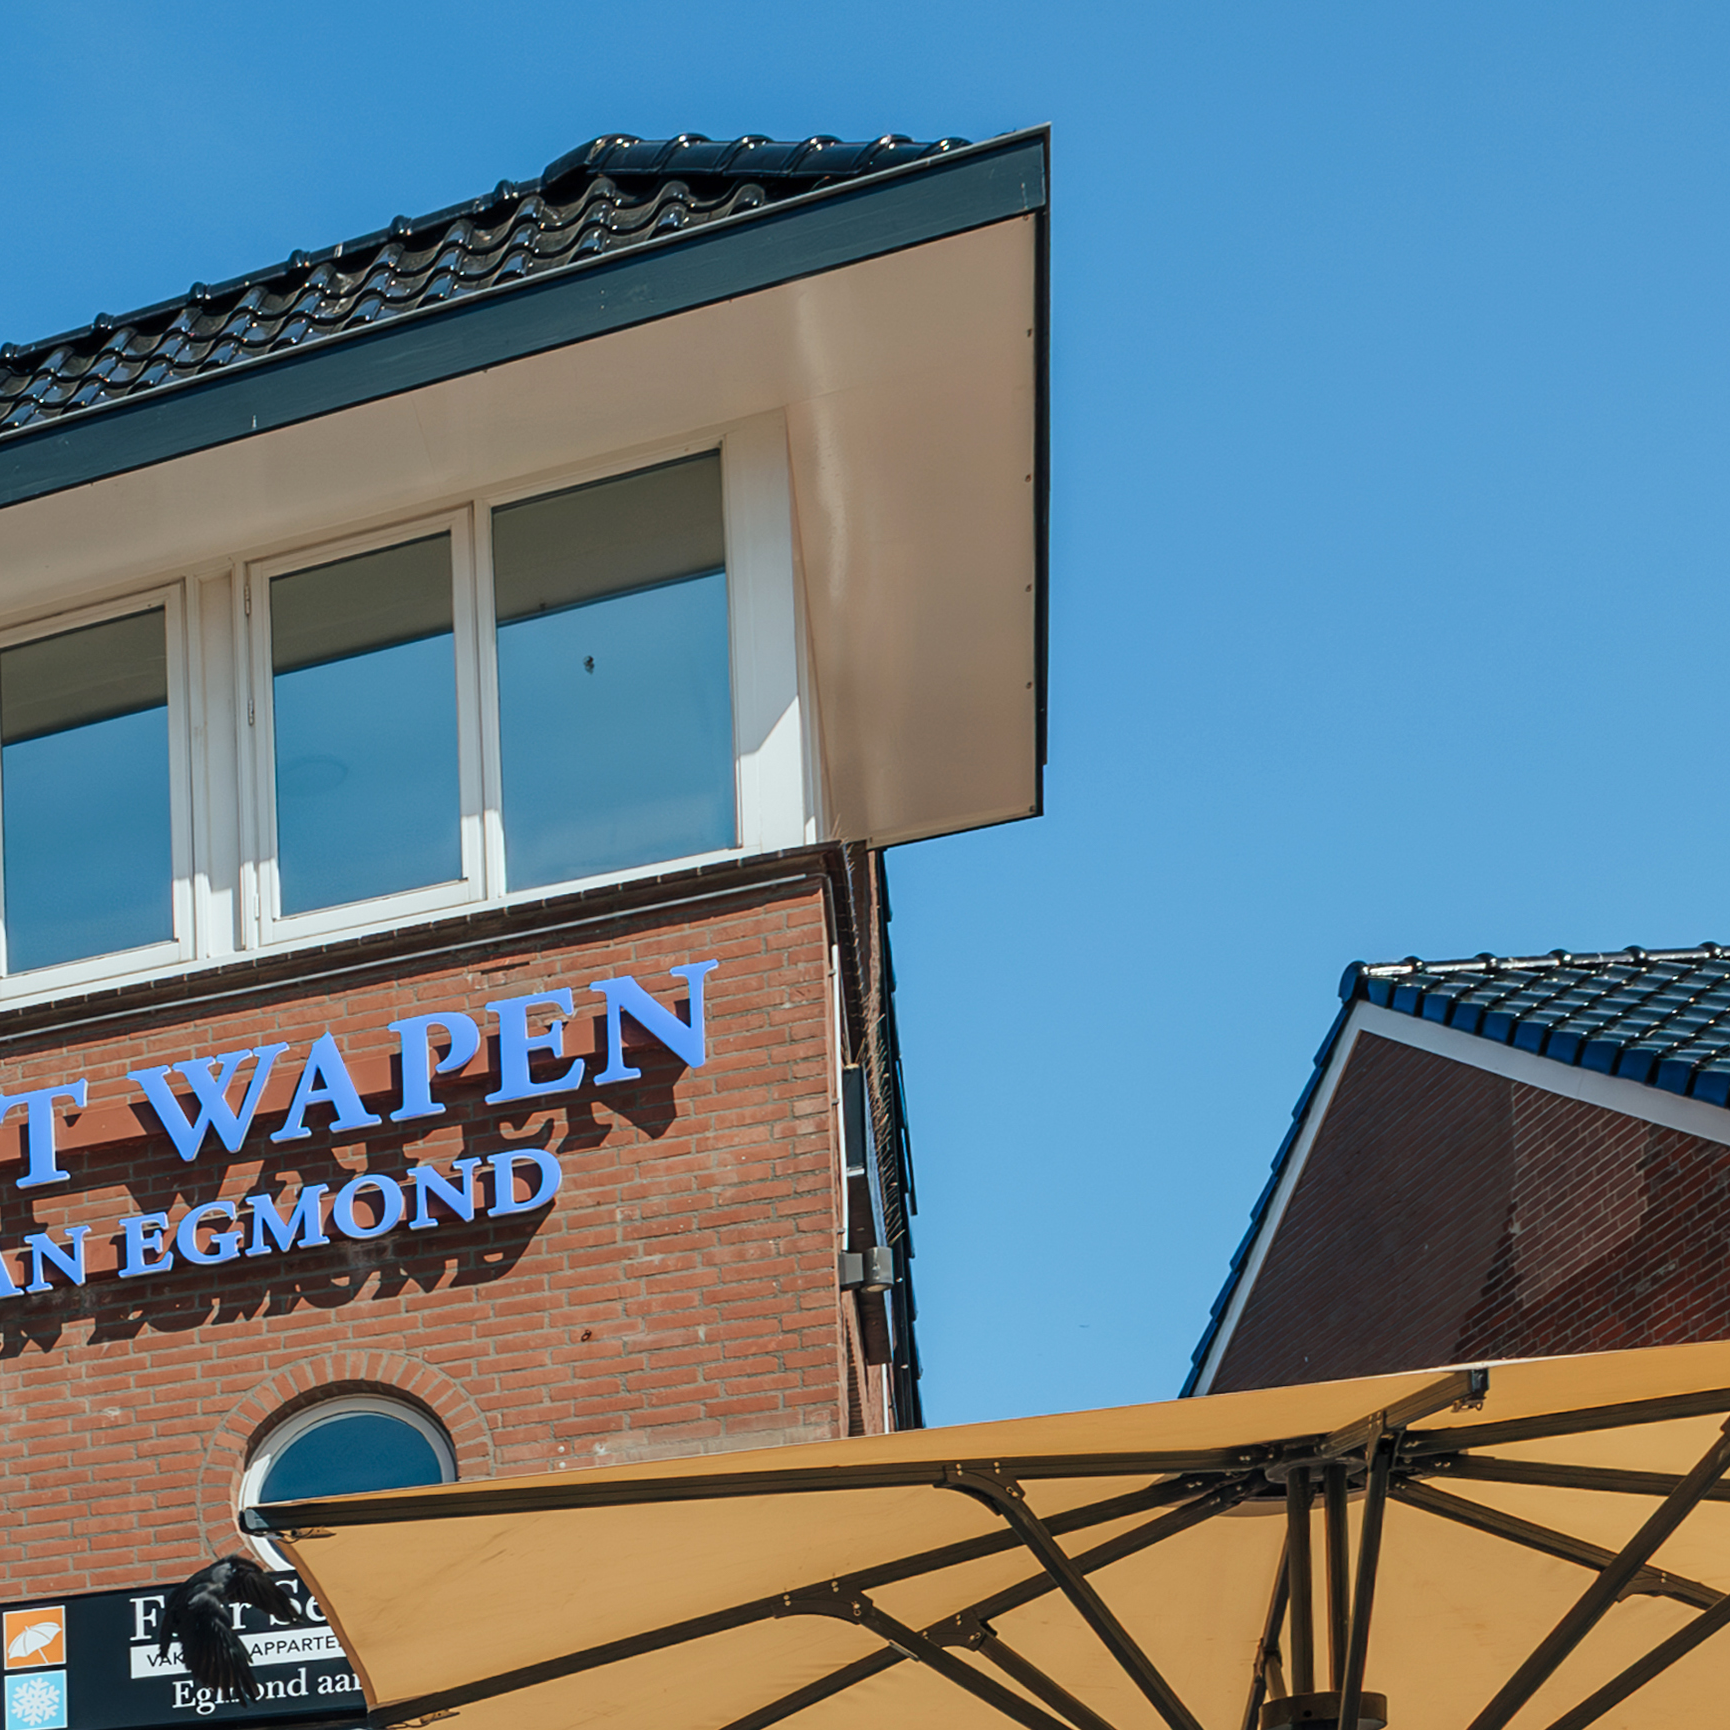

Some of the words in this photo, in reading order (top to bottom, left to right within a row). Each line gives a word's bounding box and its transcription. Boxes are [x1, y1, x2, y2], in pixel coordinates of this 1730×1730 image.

[127, 959, 719, 1162] WAPEN
[118, 1147, 563, 1277] EGMOND
[129, 1595, 252, 1641] Fr
[250, 1635, 342, 1656] APPARTE
